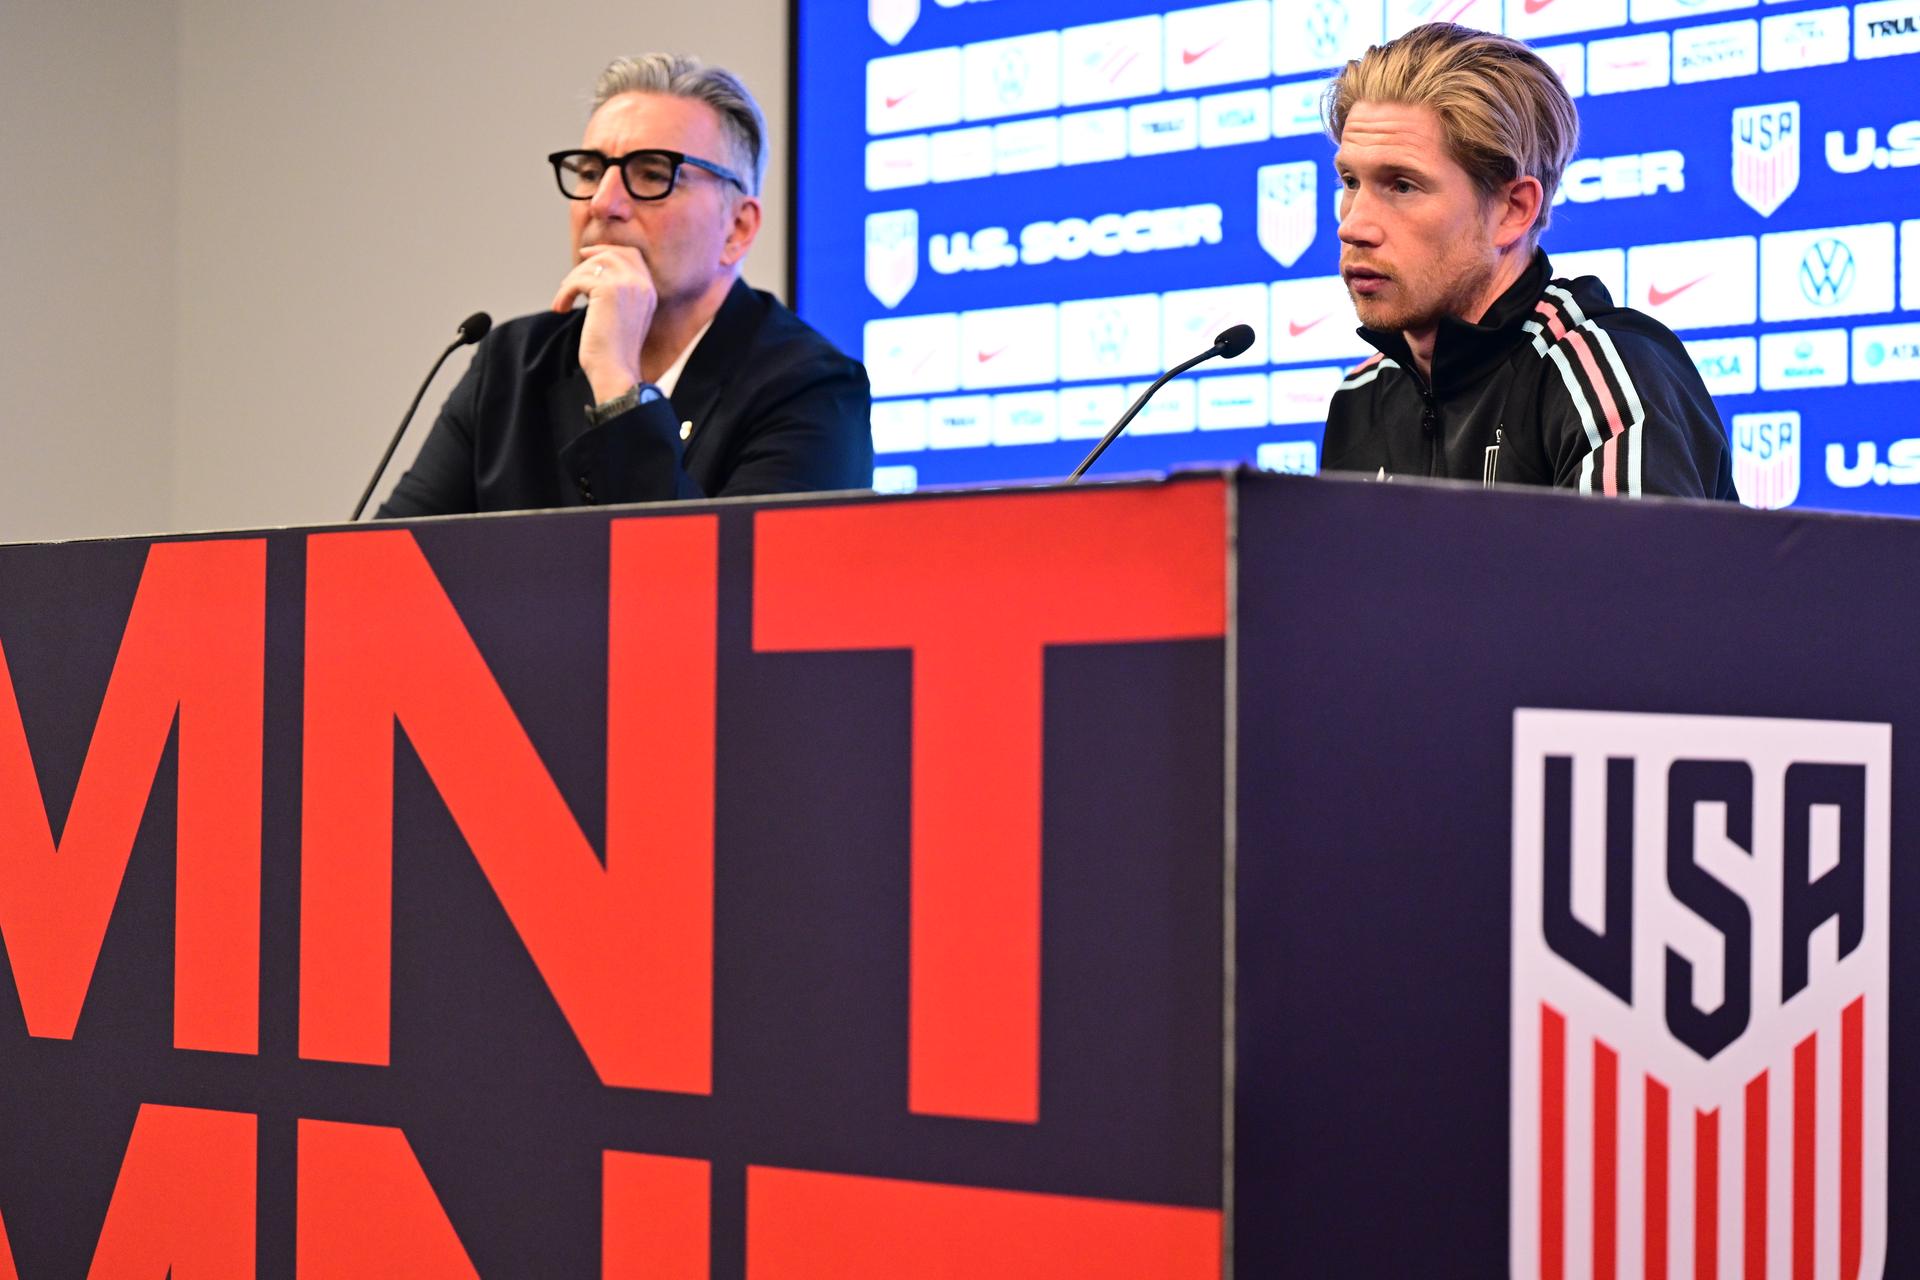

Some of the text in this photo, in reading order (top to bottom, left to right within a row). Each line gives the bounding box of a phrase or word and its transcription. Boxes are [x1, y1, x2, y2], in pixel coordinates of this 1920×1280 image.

[1868, 16, 1920, 38] TRUL
[1740, 111, 1793, 152] USA
[929, 227, 1018, 274] U.S.
[1020, 203, 1222, 265] SOCCER
[1739, 421, 1793, 461] USA
[1541, 754, 1867, 1062] USA
